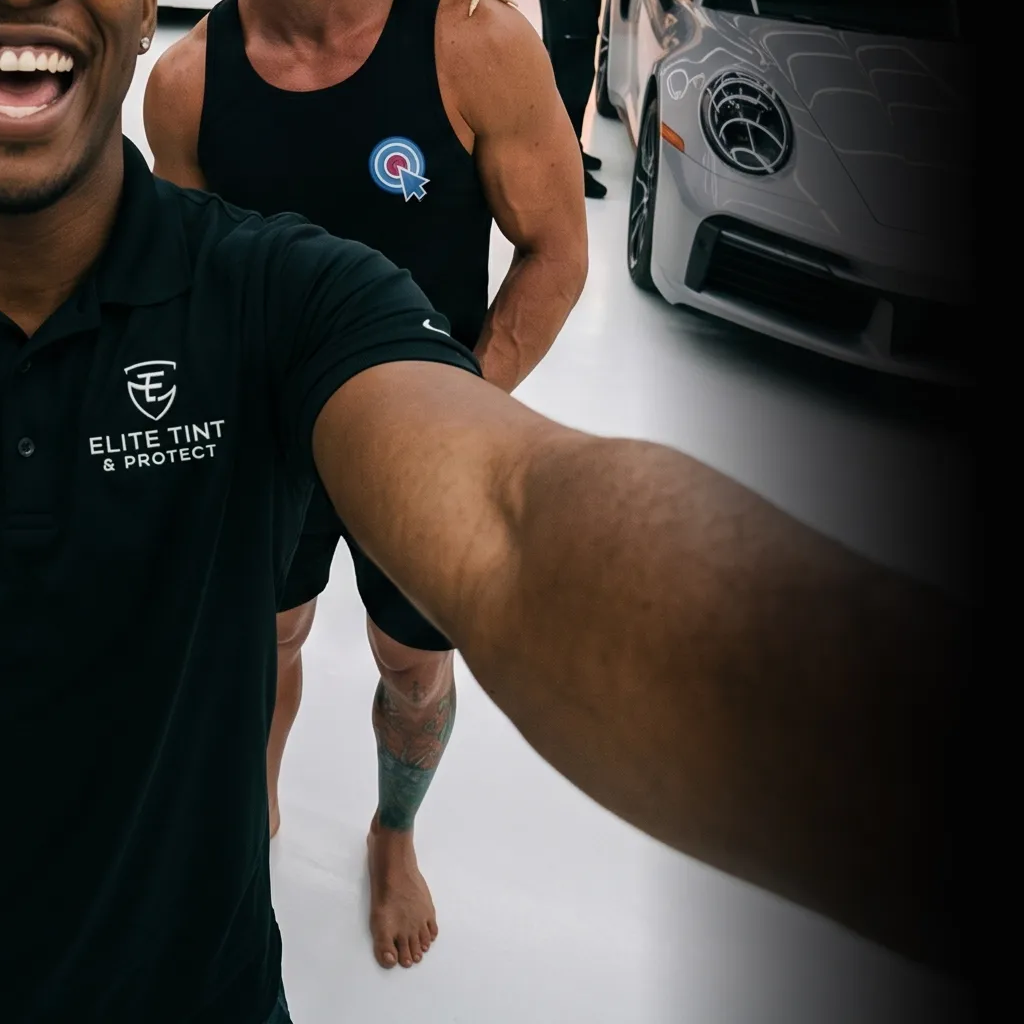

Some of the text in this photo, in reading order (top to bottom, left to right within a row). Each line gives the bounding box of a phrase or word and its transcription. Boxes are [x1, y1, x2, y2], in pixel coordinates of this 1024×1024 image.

[89, 419, 225, 455] ELITE TINT
[103, 444, 216, 472] & PROTECT
